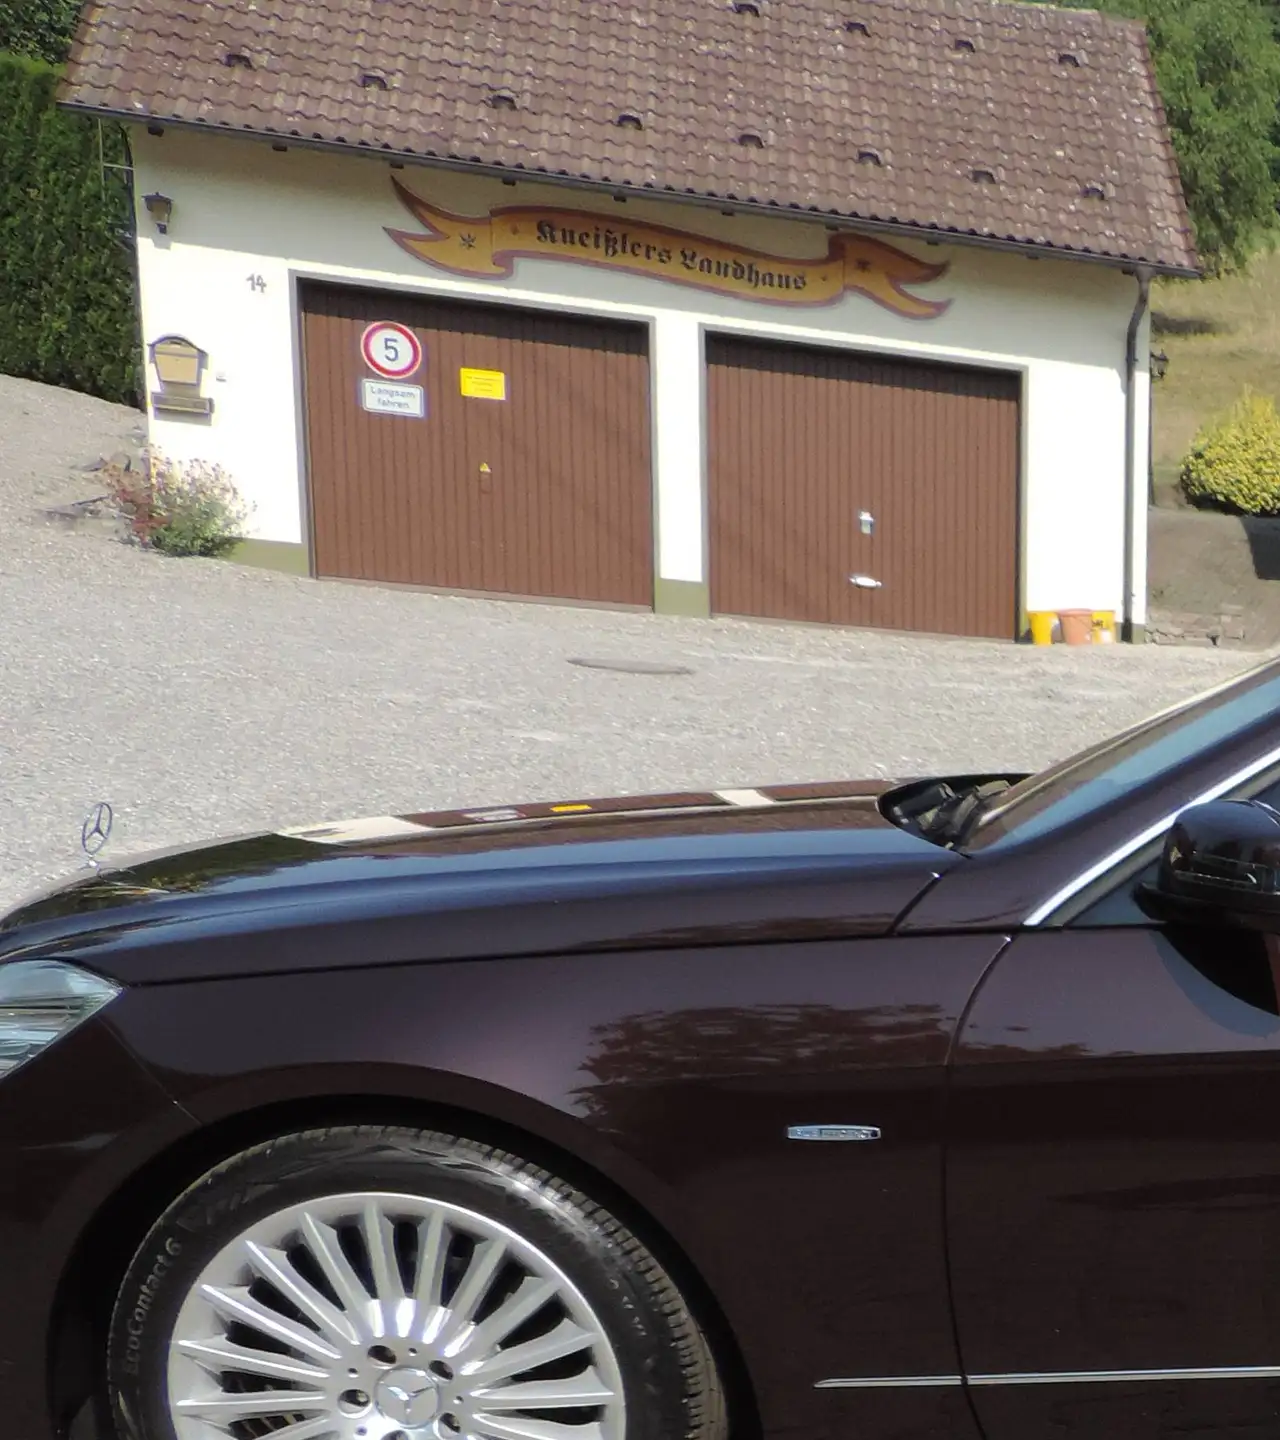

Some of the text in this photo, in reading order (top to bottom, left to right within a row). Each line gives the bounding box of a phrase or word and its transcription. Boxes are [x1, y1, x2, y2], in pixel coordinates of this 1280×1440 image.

[246, 273, 267, 293] 14
[680, 246, 806, 289] Landhaus
[383, 337, 399, 362] 5
[126, 1236, 182, 1375] EcoContact 6
